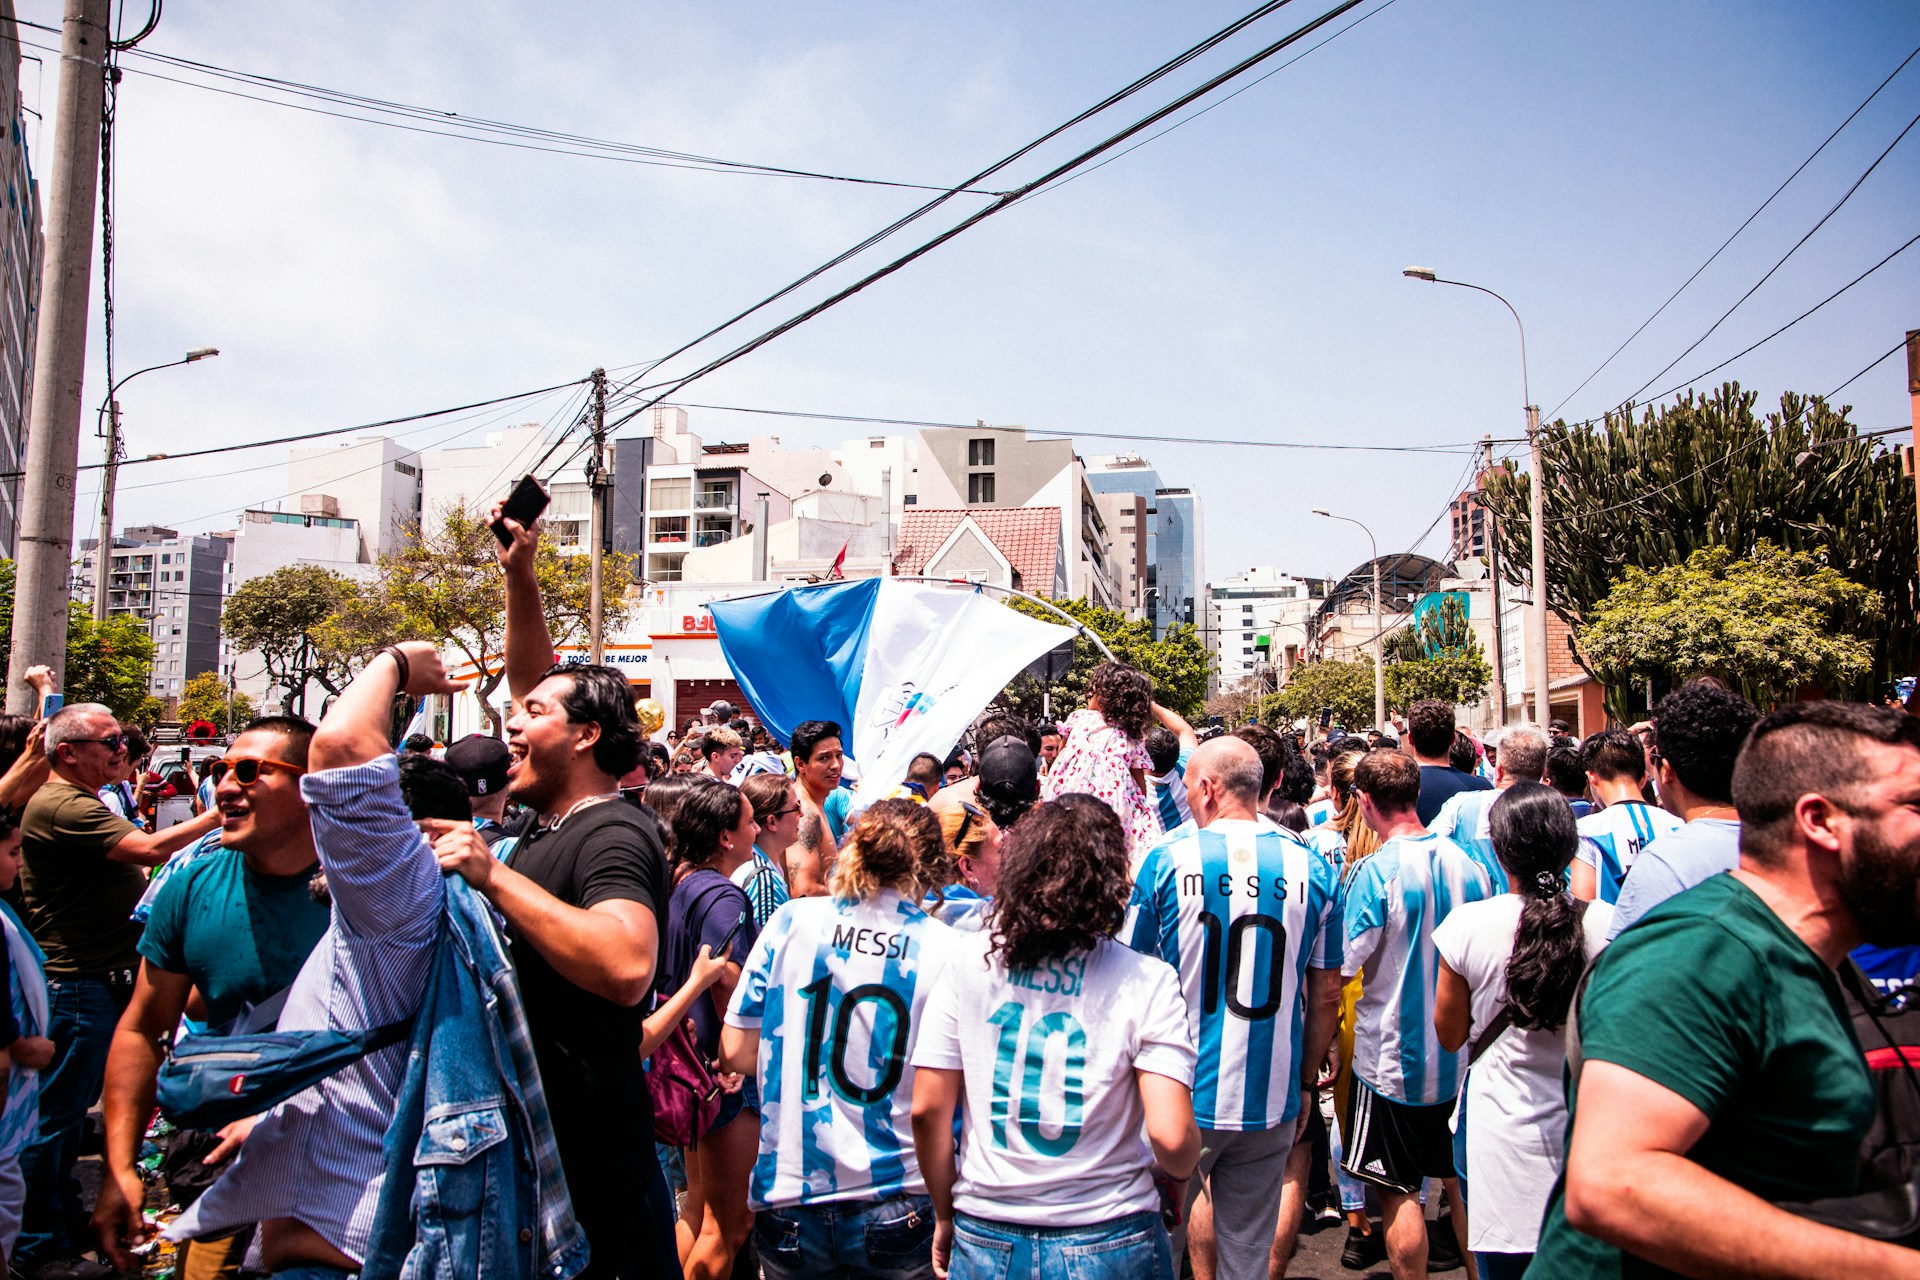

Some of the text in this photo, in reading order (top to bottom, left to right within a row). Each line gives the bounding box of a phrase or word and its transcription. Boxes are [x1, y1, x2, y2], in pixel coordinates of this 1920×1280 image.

[56, 475, 72, 490] 03
[605, 655, 616, 663] BE
[618, 655, 648, 663] MEJOR
[1183, 873, 1304, 905] MESSI
[831, 924, 911, 961] MESSI
[1007, 956, 1087, 997] MESSI
[1198, 911, 1287, 1021] 10
[797, 973, 911, 1107] 10
[986, 1001, 1087, 1157] 10
